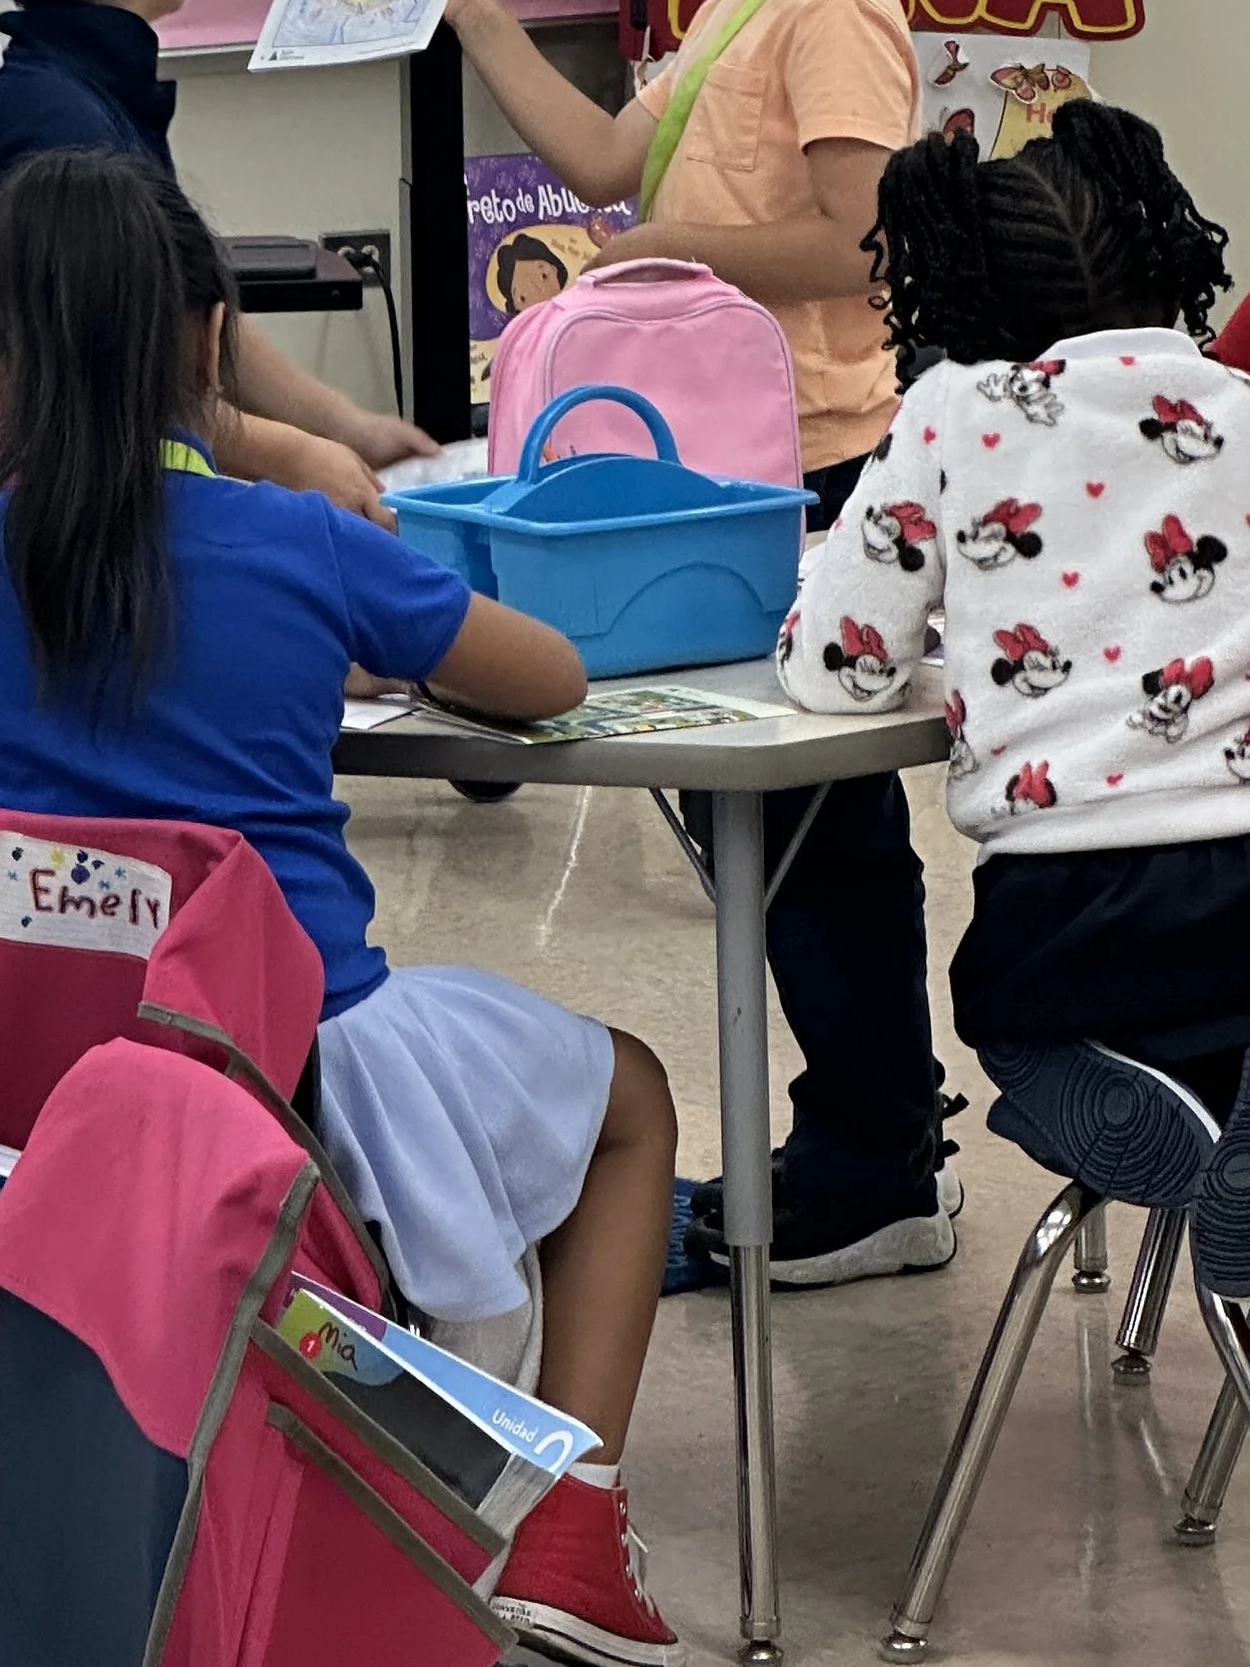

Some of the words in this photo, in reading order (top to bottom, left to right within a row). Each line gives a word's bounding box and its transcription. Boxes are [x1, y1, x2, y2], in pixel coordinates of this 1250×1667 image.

[467, 189, 517, 224] reto
[516, 187, 535, 213] de
[492, 1408, 537, 1444] Unidad
